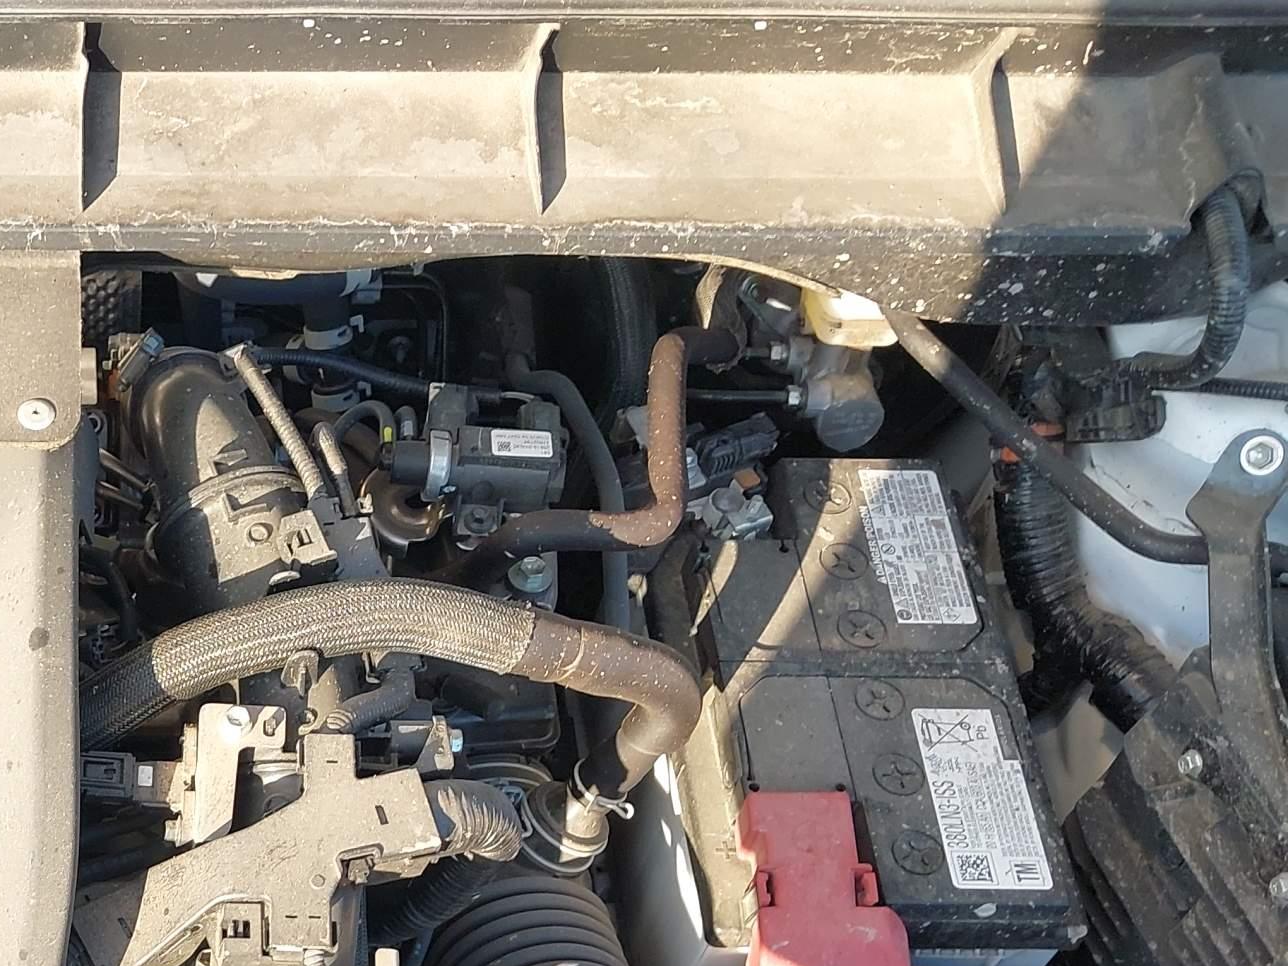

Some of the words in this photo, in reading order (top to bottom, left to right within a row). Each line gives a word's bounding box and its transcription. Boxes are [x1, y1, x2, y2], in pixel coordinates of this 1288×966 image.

[975, 725, 990, 740] Pb
[931, 780, 969, 848] 380LN3-ISS
[1013, 863, 1041, 883] TM
